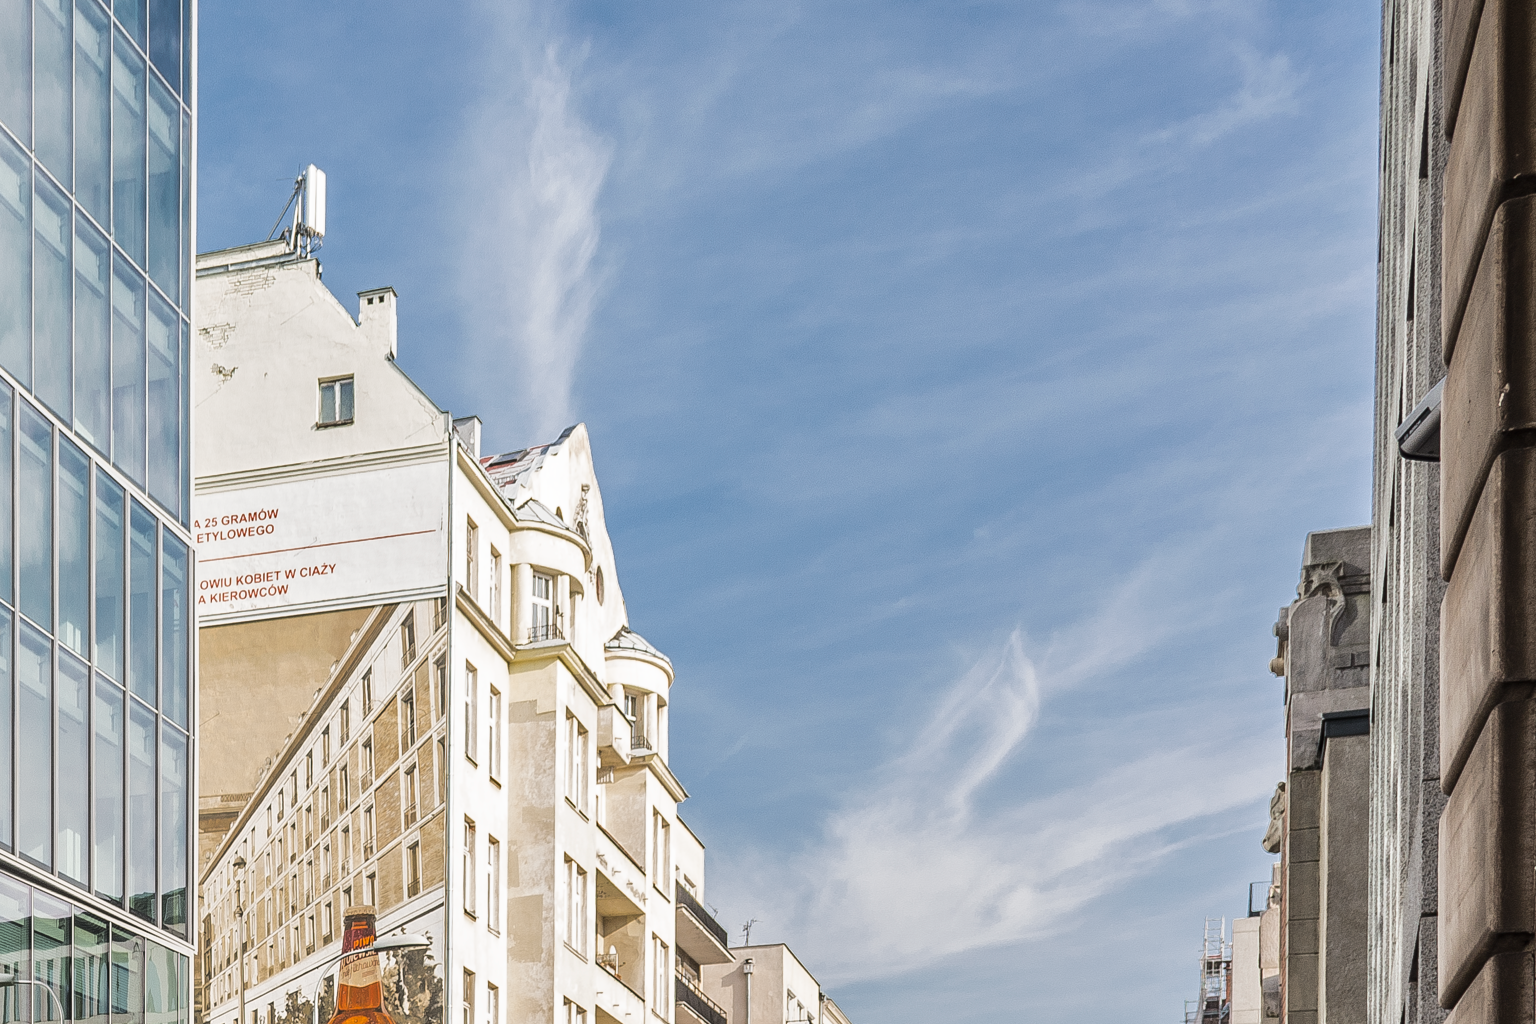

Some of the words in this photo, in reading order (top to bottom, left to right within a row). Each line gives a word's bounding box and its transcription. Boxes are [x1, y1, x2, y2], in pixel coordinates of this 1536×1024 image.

[204, 517, 218, 528] 25
[221, 508, 279, 526] GRAMÓW
[196, 524, 275, 544] ETYLOWEGO
[235, 570, 281, 586] KOBIET
[284, 568, 297, 579] W
[210, 584, 289, 603] KIEROWCÓW
